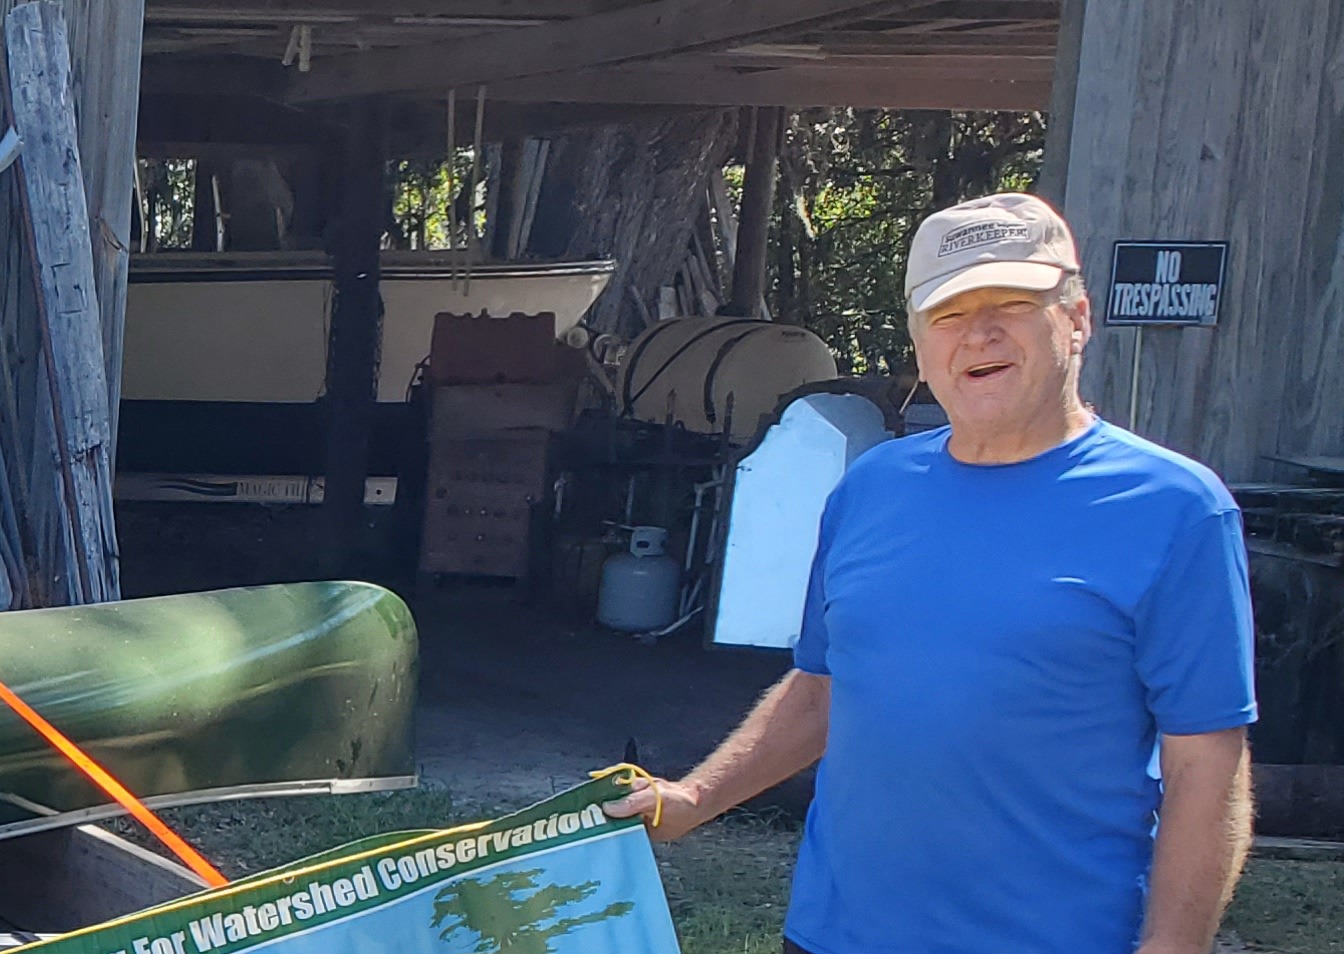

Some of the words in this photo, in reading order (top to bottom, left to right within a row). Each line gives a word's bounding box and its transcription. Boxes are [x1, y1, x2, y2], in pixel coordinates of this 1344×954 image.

[1155, 250, 1182, 283] NO
[1113, 283, 1217, 317] TRESPASSING
[188, 866, 379, 954] Watershed
[377, 803, 607, 892] Conservation
